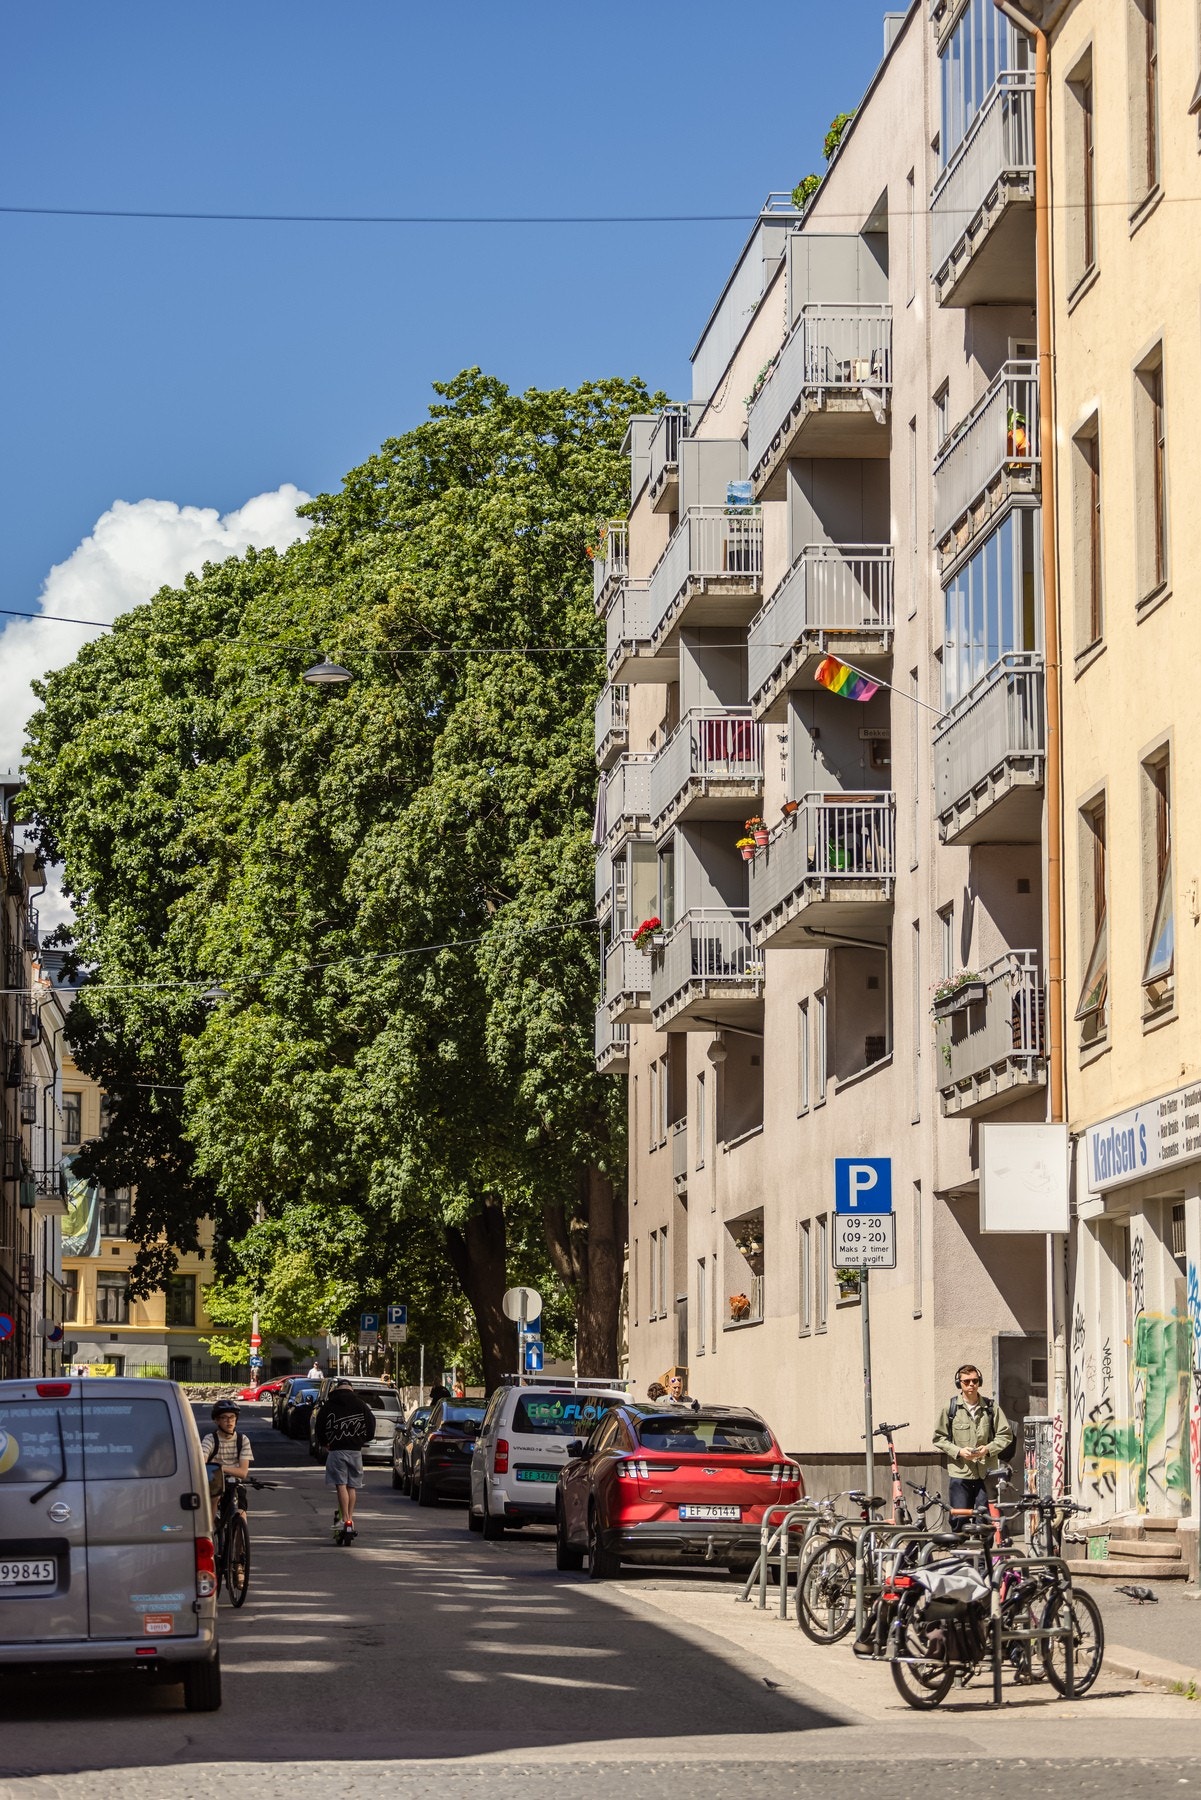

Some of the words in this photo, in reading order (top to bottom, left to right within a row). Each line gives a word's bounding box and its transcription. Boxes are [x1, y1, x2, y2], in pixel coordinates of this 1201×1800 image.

[849, 1165, 878, 1207] P
[839, 1245, 859, 1253] Maks
[862, 1245, 867, 1253] 2
[870, 1245, 889, 1253] timer
[862, 1255, 884, 1264] avgift
[392, 1307, 402, 1322] P
[364, 1315, 374, 1329] P
[690, 1506, 702, 1516] EF
[706, 1506, 736, 1517] 76144
[1, 1563, 51, 1580] 99845
